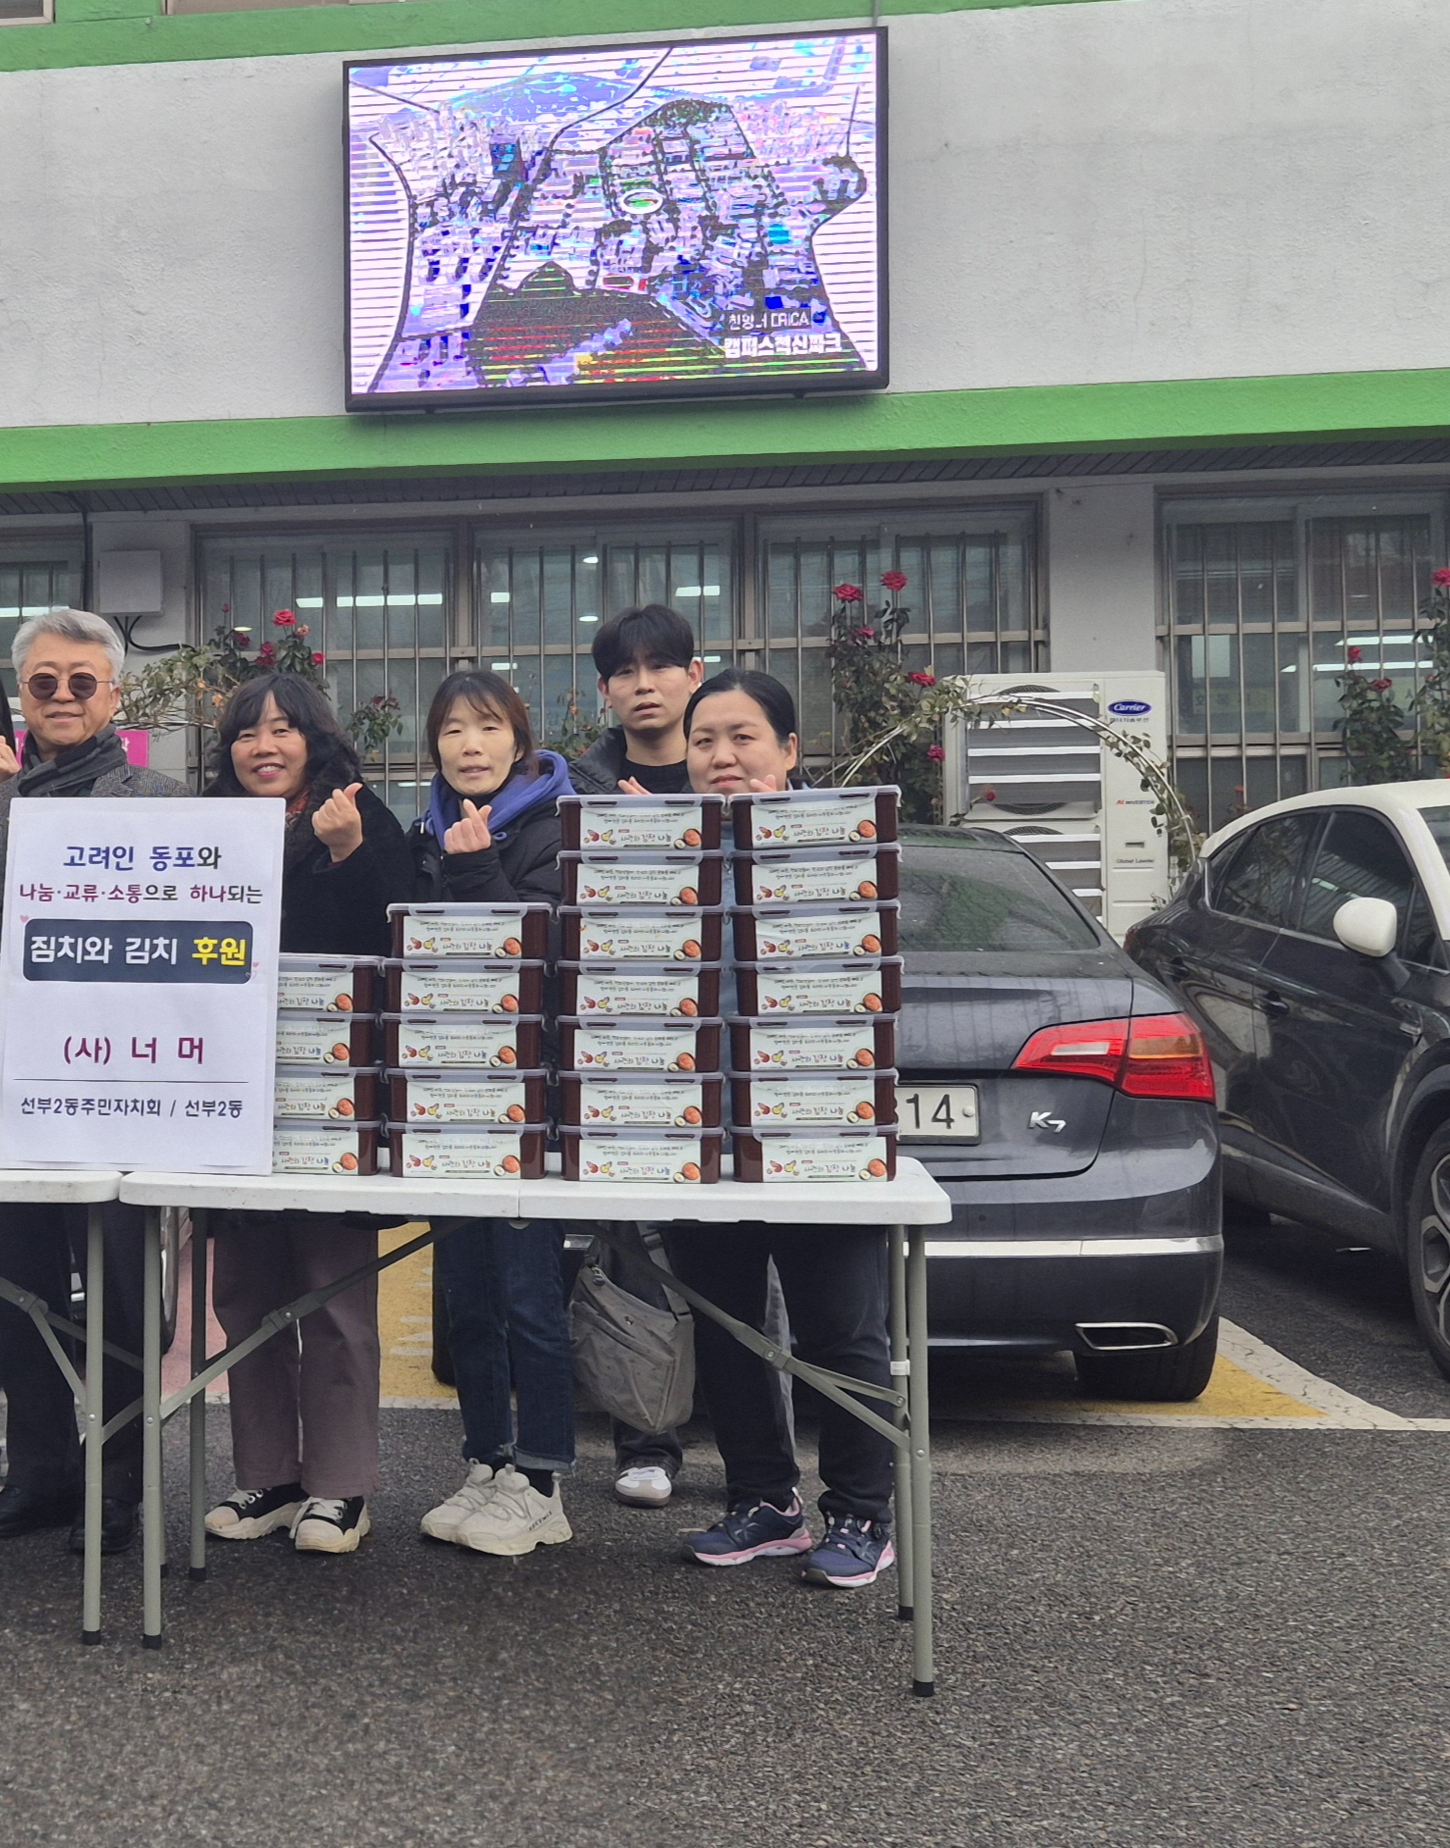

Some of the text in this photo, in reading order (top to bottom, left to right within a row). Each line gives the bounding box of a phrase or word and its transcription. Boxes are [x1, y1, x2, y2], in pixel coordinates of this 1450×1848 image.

[1113, 703, 1146, 712] Carrier
[63, 845, 222, 872] 고려인 동포와
[190, 885, 263, 904] 하나되는
[30, 935, 246, 966] 짐치와 김치 후원
[63, 1036, 112, 1065] (사)
[21, 1097, 162, 1117] 선부2동주민자치회
[184, 1099, 243, 1119] 선부2동
[905, 1093, 955, 1130] 14
[1028, 1111, 1067, 1133] K7
